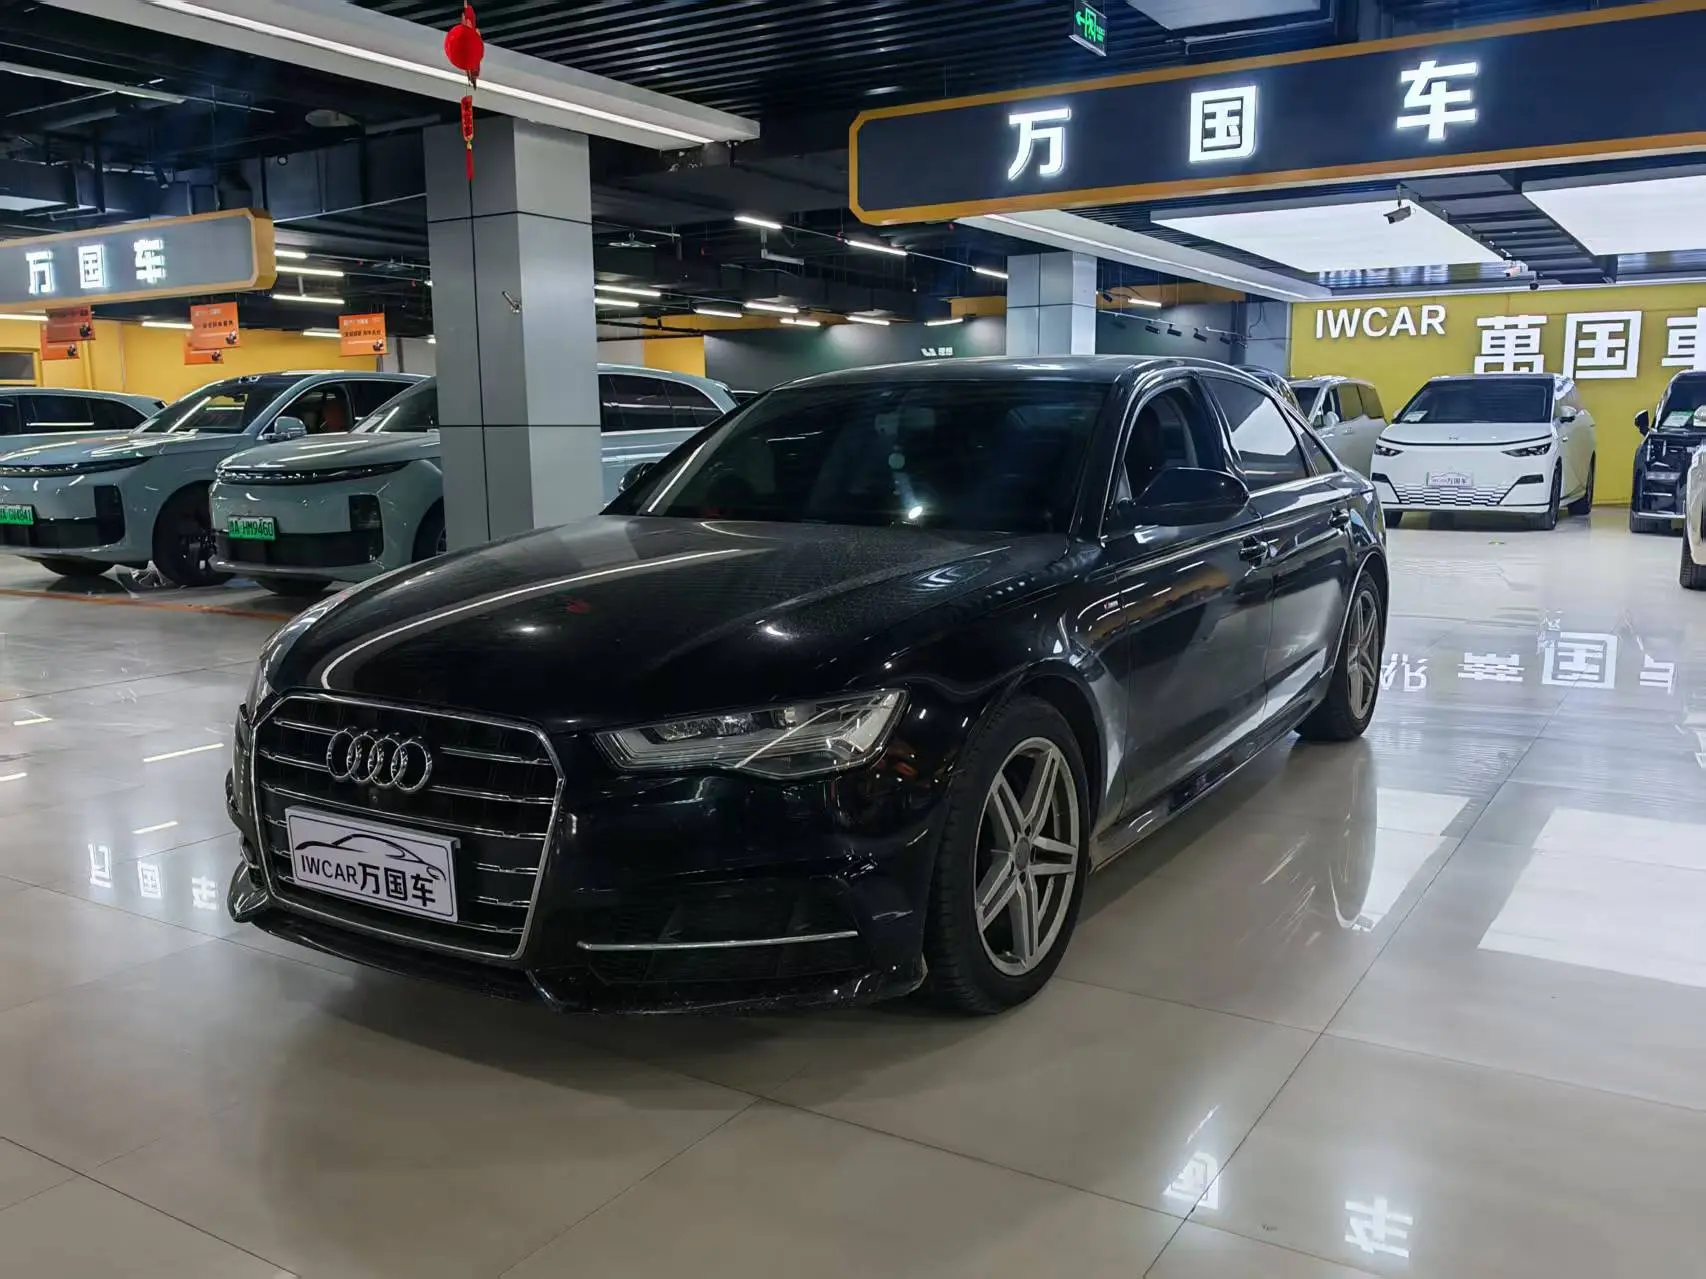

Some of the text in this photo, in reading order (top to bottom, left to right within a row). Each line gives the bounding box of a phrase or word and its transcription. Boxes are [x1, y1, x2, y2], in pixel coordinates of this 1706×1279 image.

[1007, 60, 1478, 180] 万国车
[26, 239, 166, 295] 万国车
[1315, 304, 1447, 339] IWCAR
[300, 854, 435, 907] IWCAR万国车
